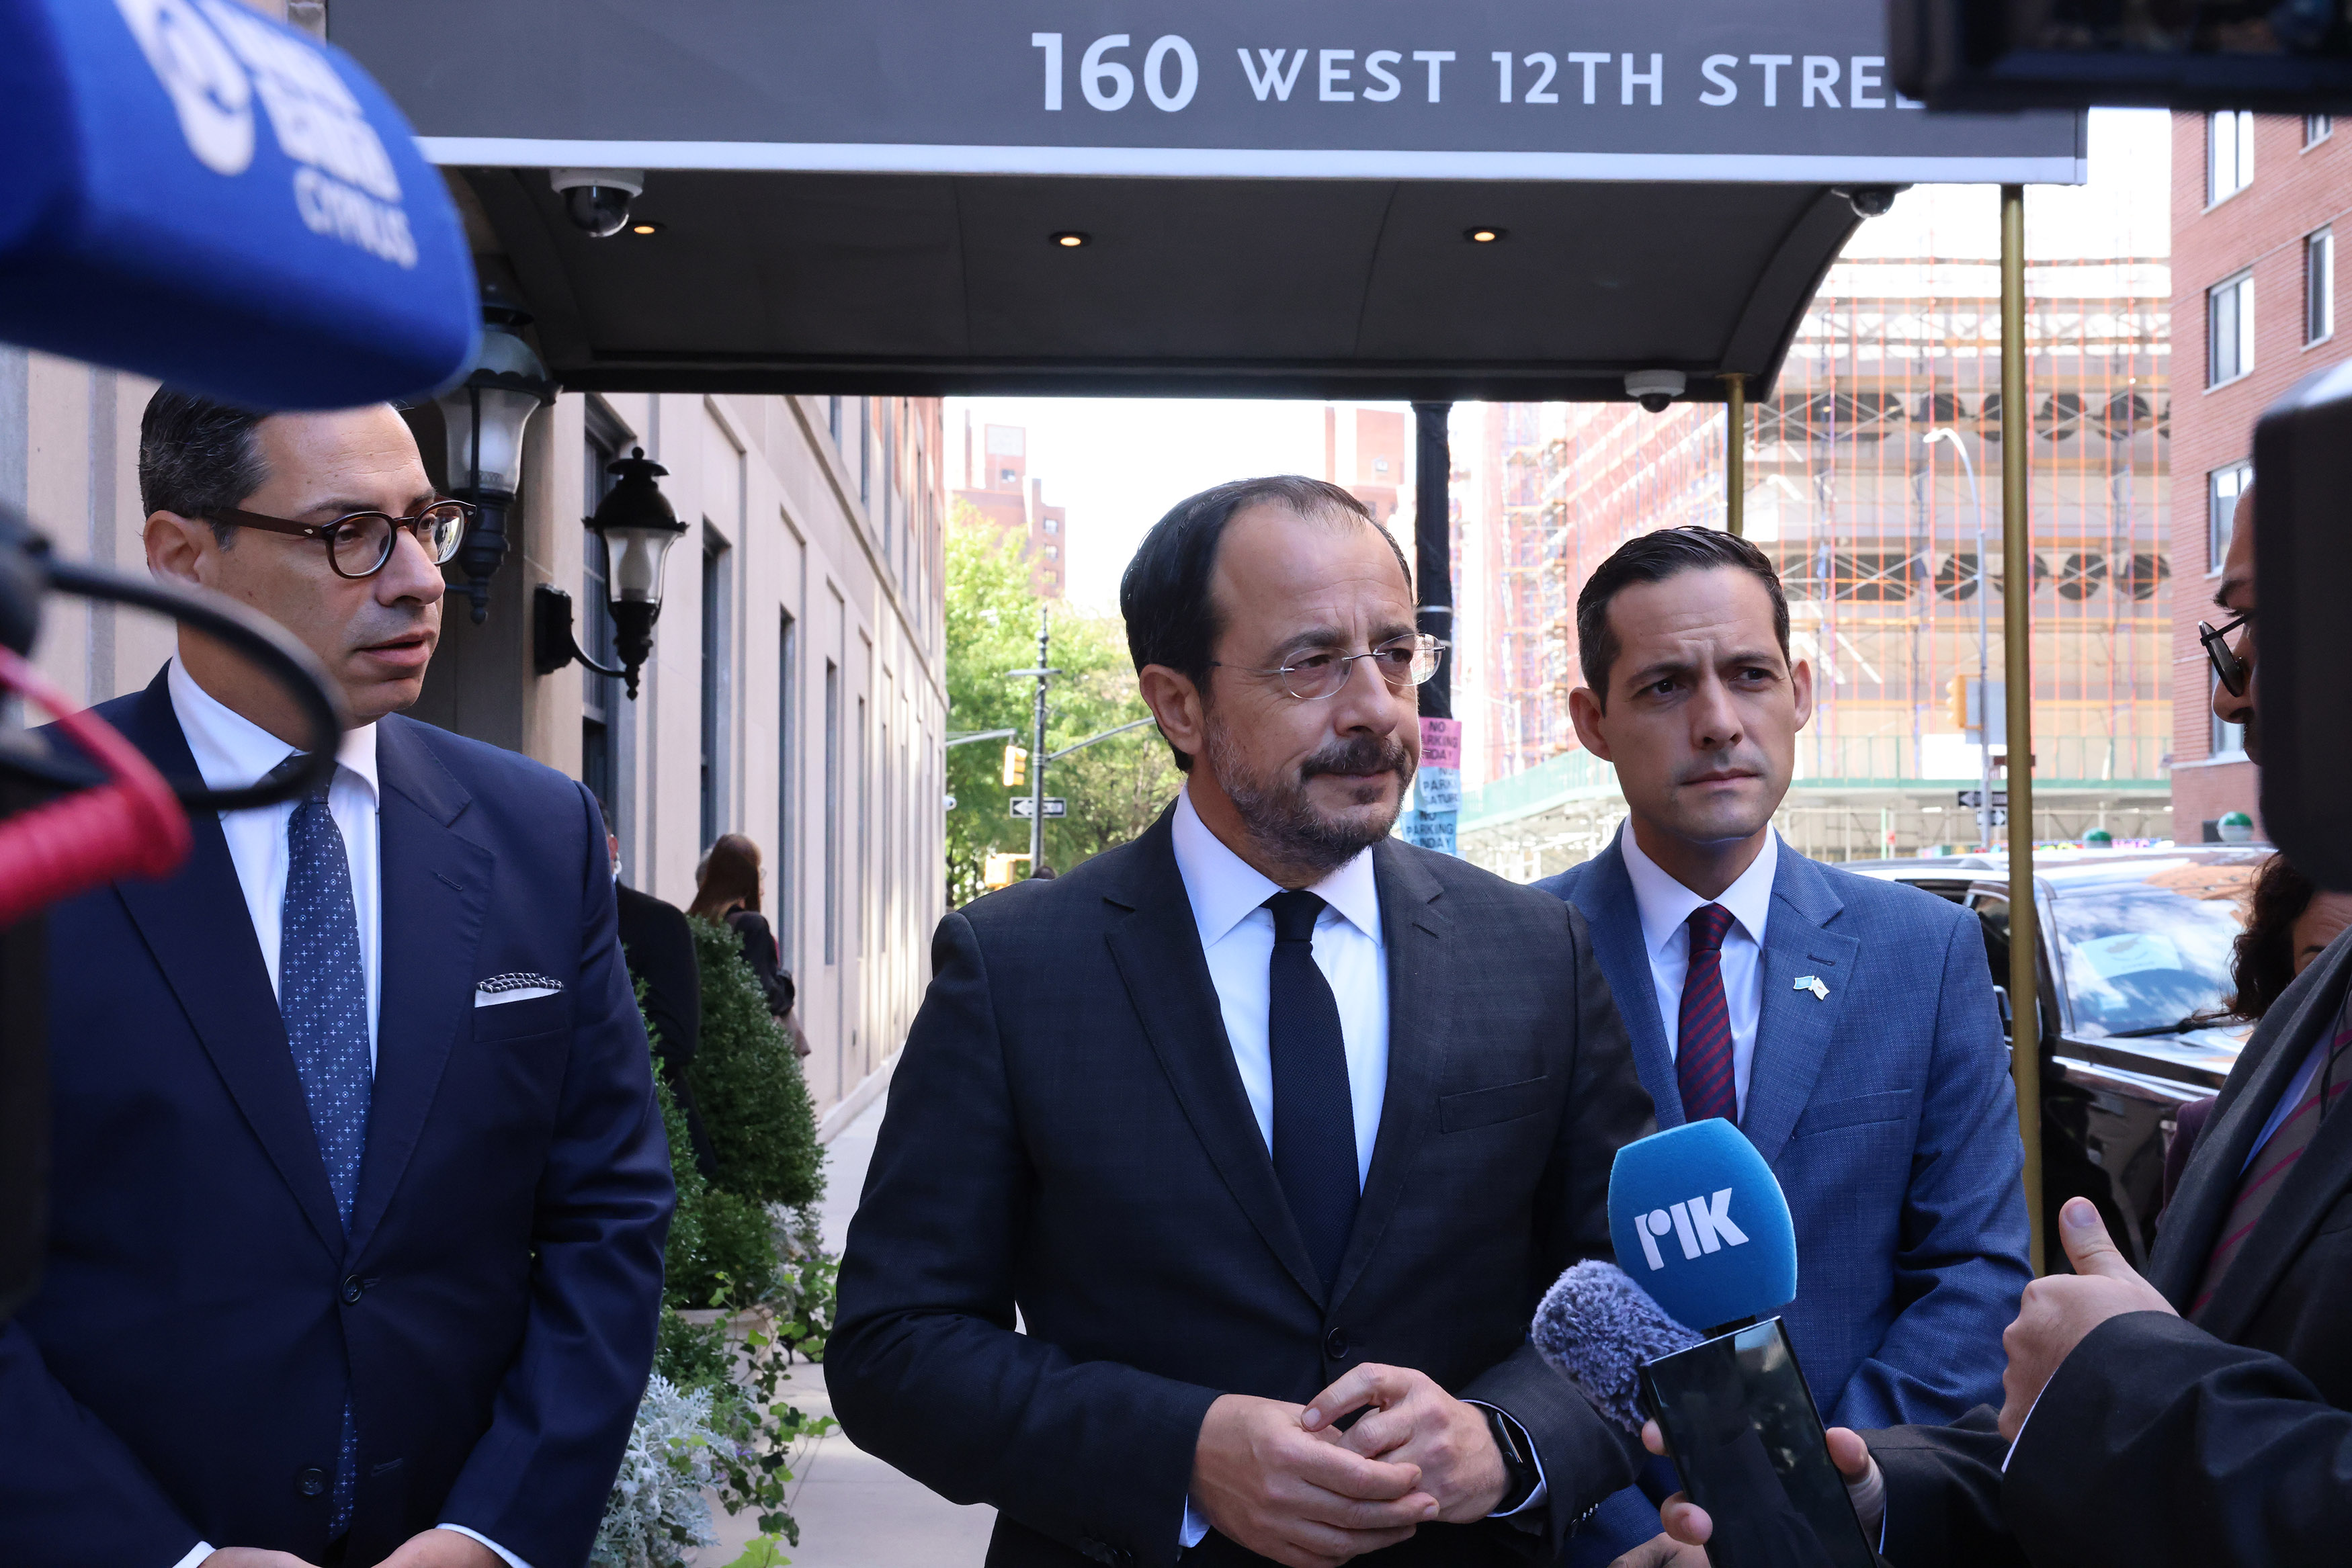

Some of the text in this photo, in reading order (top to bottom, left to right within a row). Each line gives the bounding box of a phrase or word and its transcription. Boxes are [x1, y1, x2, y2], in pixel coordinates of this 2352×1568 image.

[1032, 33, 1923, 112] 160 WEST 12TH STRE
[1429, 721, 1446, 732] NO
[1421, 734, 1458, 748] ARKING
[1406, 823, 1454, 836] PARKING
